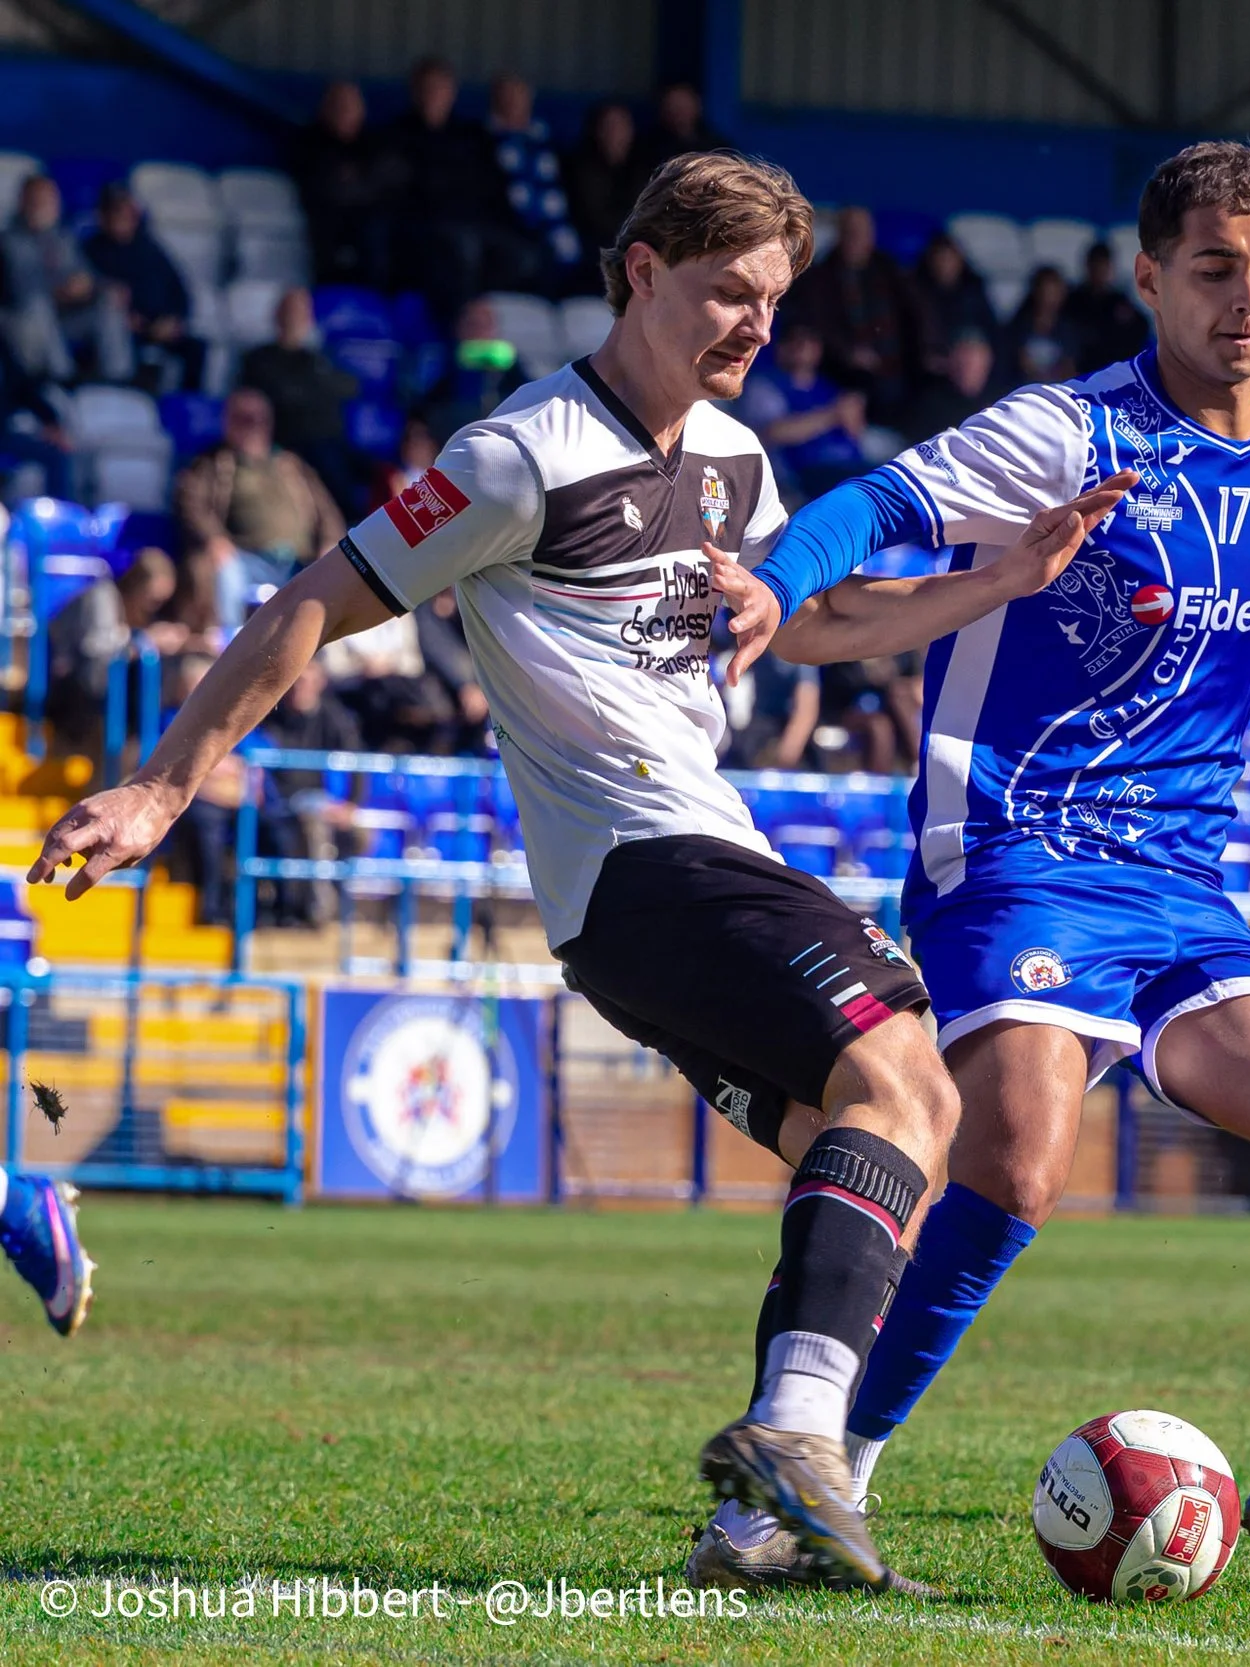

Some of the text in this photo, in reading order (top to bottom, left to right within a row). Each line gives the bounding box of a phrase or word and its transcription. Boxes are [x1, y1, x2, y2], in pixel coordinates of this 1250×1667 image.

[917, 443, 938, 460] GTS
[1117, 423, 1151, 458] ABSQUE
[1128, 505, 1182, 518] MATCHWINNER
[662, 563, 710, 610] Hyde
[1176, 1527, 1188, 1540] IN
[1183, 1509, 1206, 1554] PITCHING
